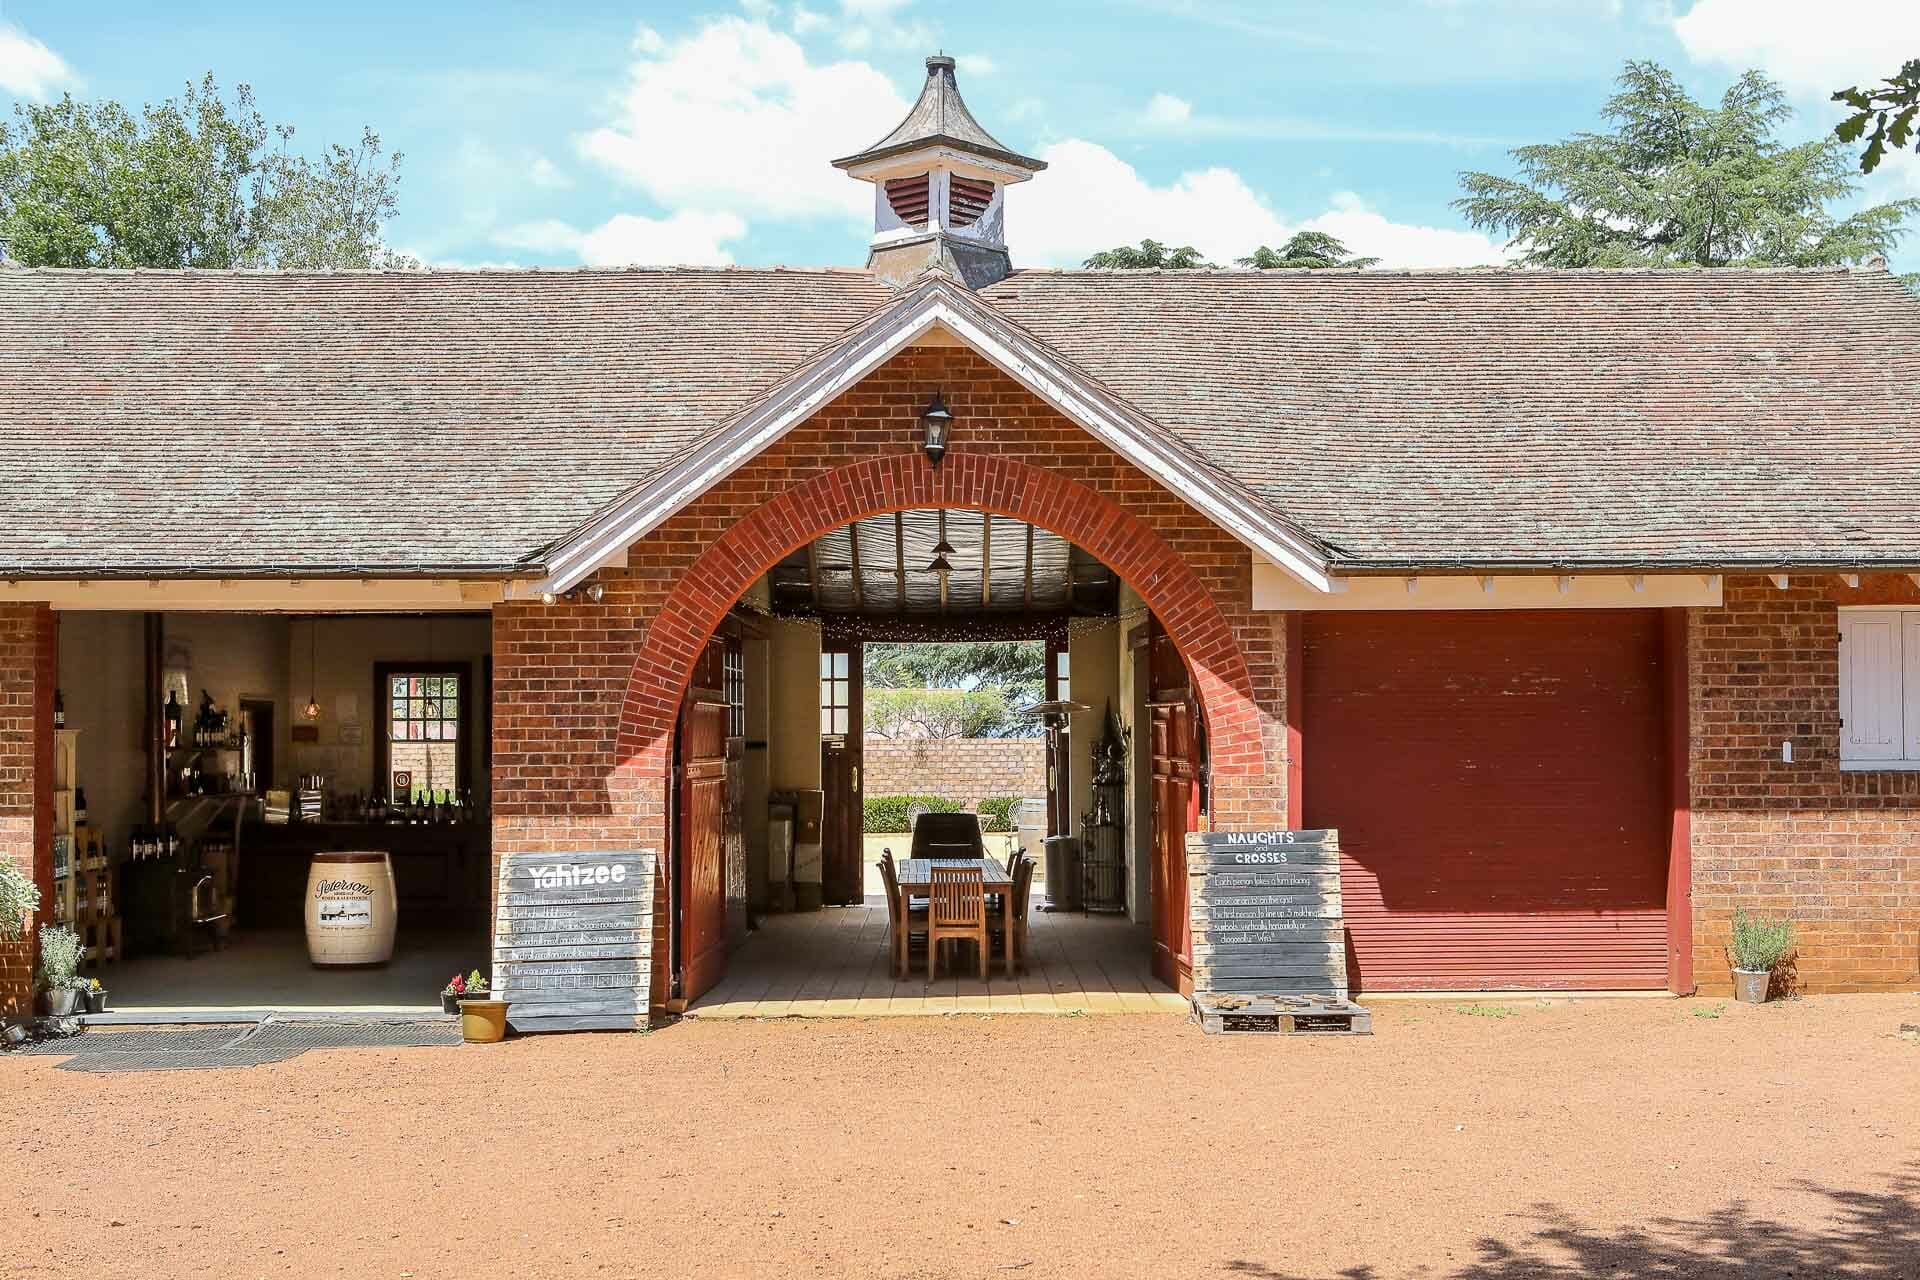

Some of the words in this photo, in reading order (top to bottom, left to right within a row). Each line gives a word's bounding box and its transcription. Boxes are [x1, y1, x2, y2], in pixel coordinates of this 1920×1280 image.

[1227, 831, 1295, 845] NAUGHTS
[1235, 852, 1288, 864] CROSSES
[528, 863, 626, 888] Yahtzee
[1214, 875, 1231, 886] Each
[1232, 879, 1253, 887] person
[1254, 873, 1270, 886] takes
[1276, 873, 1289, 885] turn
[315, 879, 375, 899] Petersons
